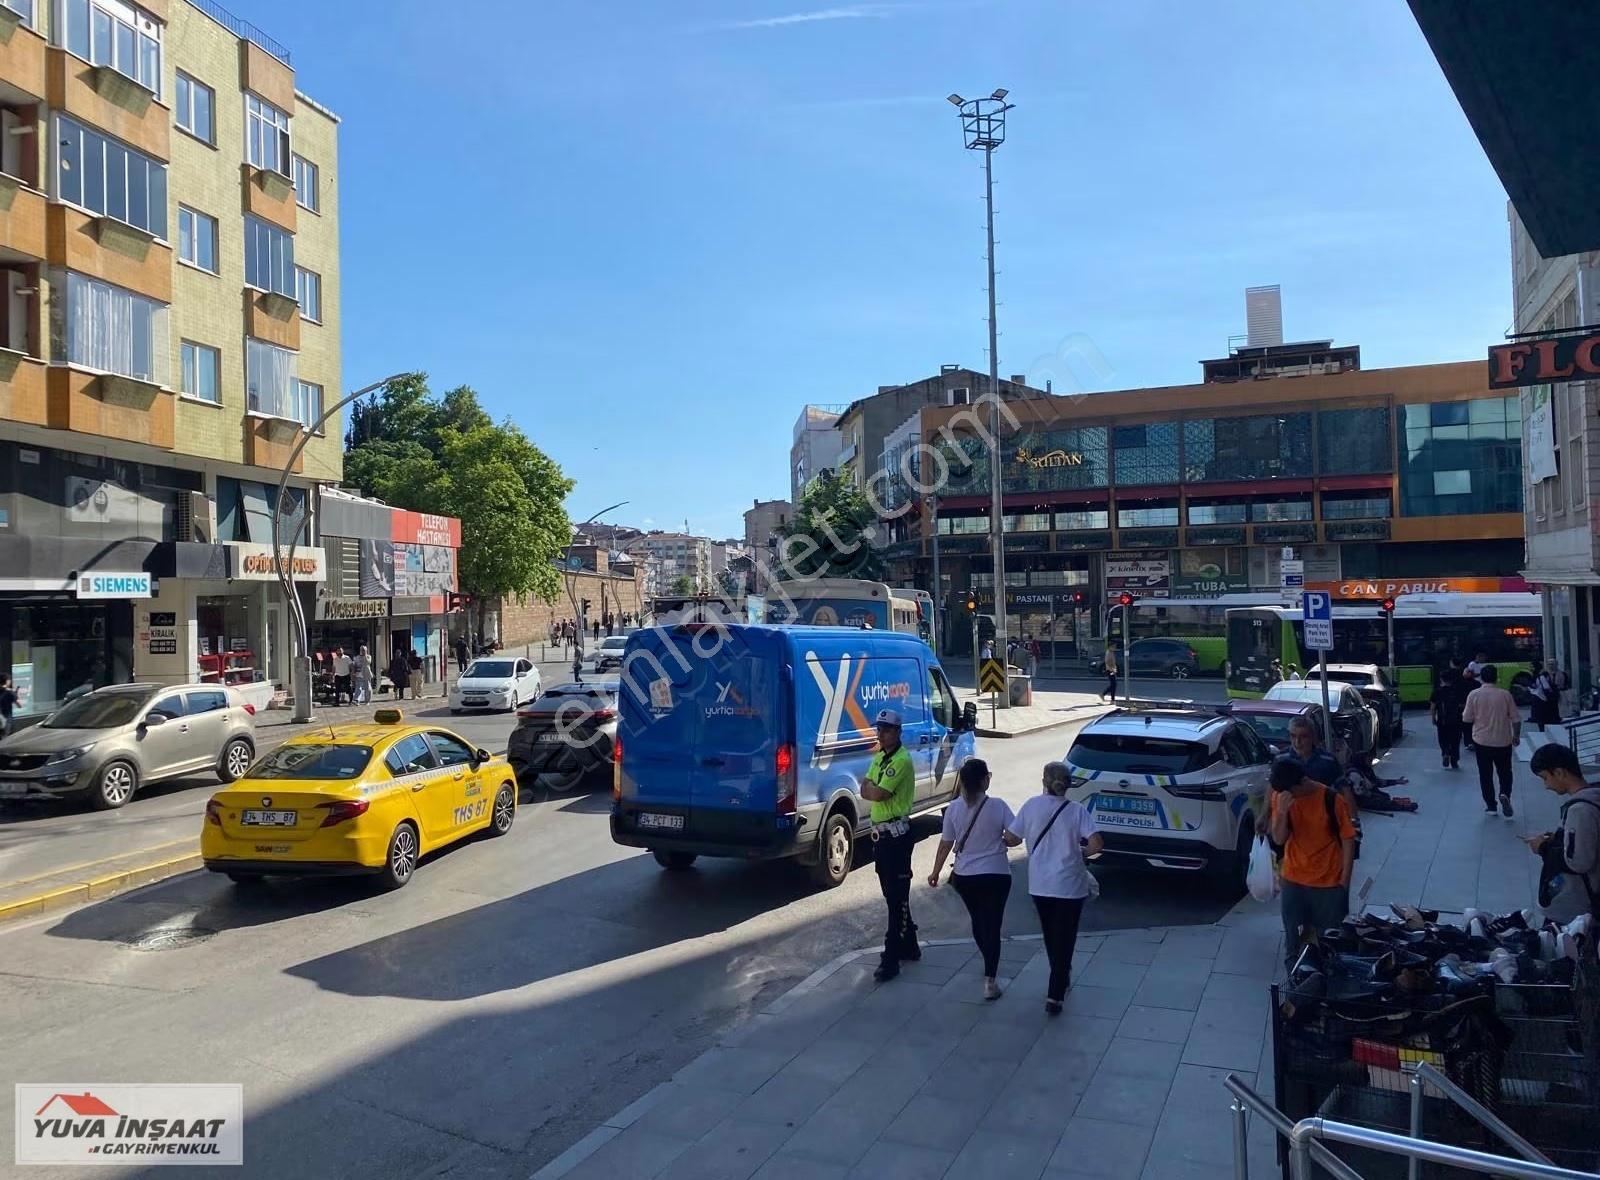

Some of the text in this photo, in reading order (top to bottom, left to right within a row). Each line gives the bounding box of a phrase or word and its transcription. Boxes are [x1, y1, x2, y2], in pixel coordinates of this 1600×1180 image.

[1031, 450, 1083, 468] SULTAN
[420, 513, 449, 531] TELEFON
[94, 577, 148, 593] SIEMENS
[1193, 581, 1228, 592] TUBA
[1340, 584, 1379, 595] CAN
[1308, 594, 1324, 618] P
[283, 812, 294, 822] 87
[454, 798, 488, 826] THS 87
[1097, 814, 1126, 824] TRAFİK
